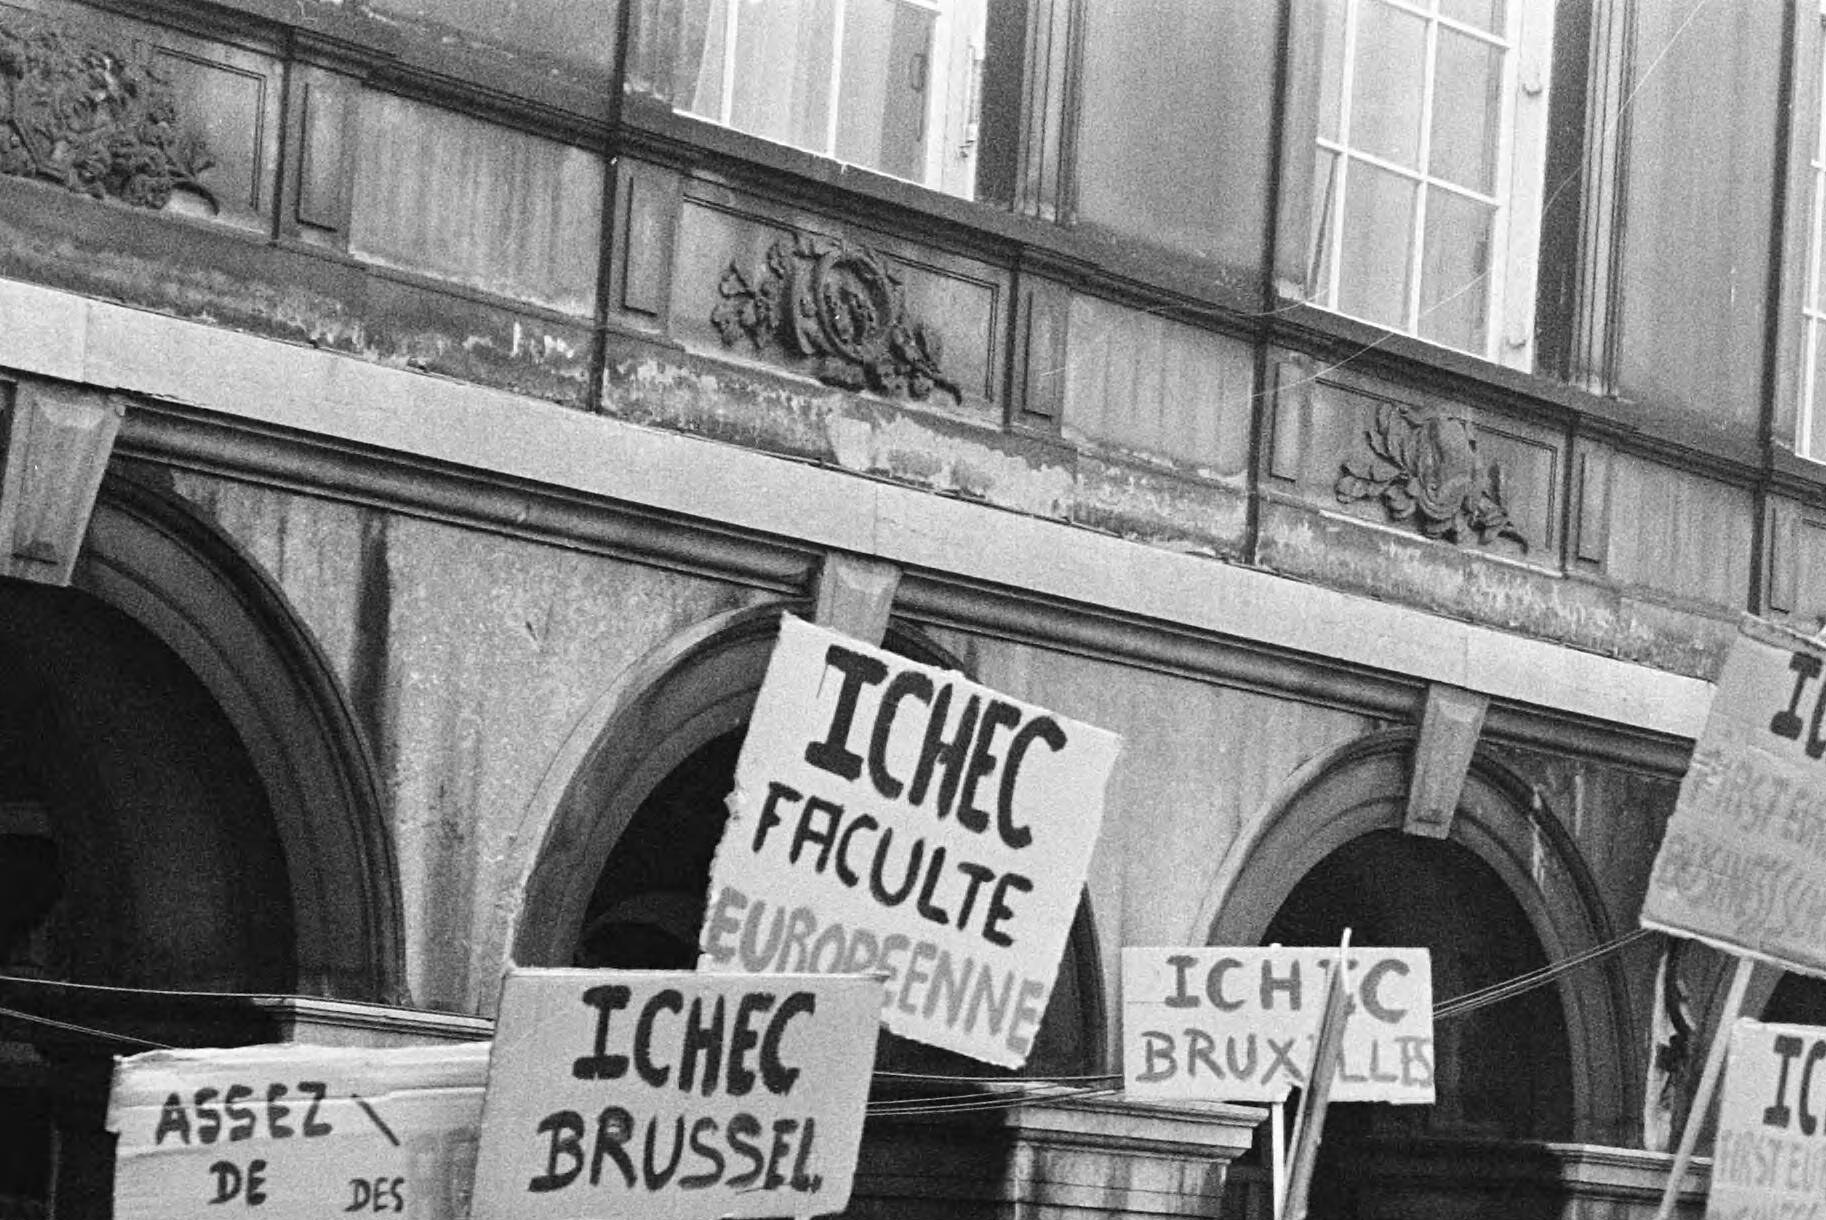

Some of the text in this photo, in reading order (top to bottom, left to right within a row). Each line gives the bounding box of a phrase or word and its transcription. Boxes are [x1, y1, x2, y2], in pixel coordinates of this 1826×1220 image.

[804, 644, 1068, 849] ICHEC
[752, 782, 1034, 947] FACULTE
[572, 984, 816, 1096] ICHEC
[1136, 1028, 1435, 1087] BRUXLLES
[156, 1081, 333, 1145] ASSEZ
[527, 1105, 823, 1193] BRUSSEL
[208, 1159, 268, 1206] DE
[345, 1177, 404, 1213] DES
